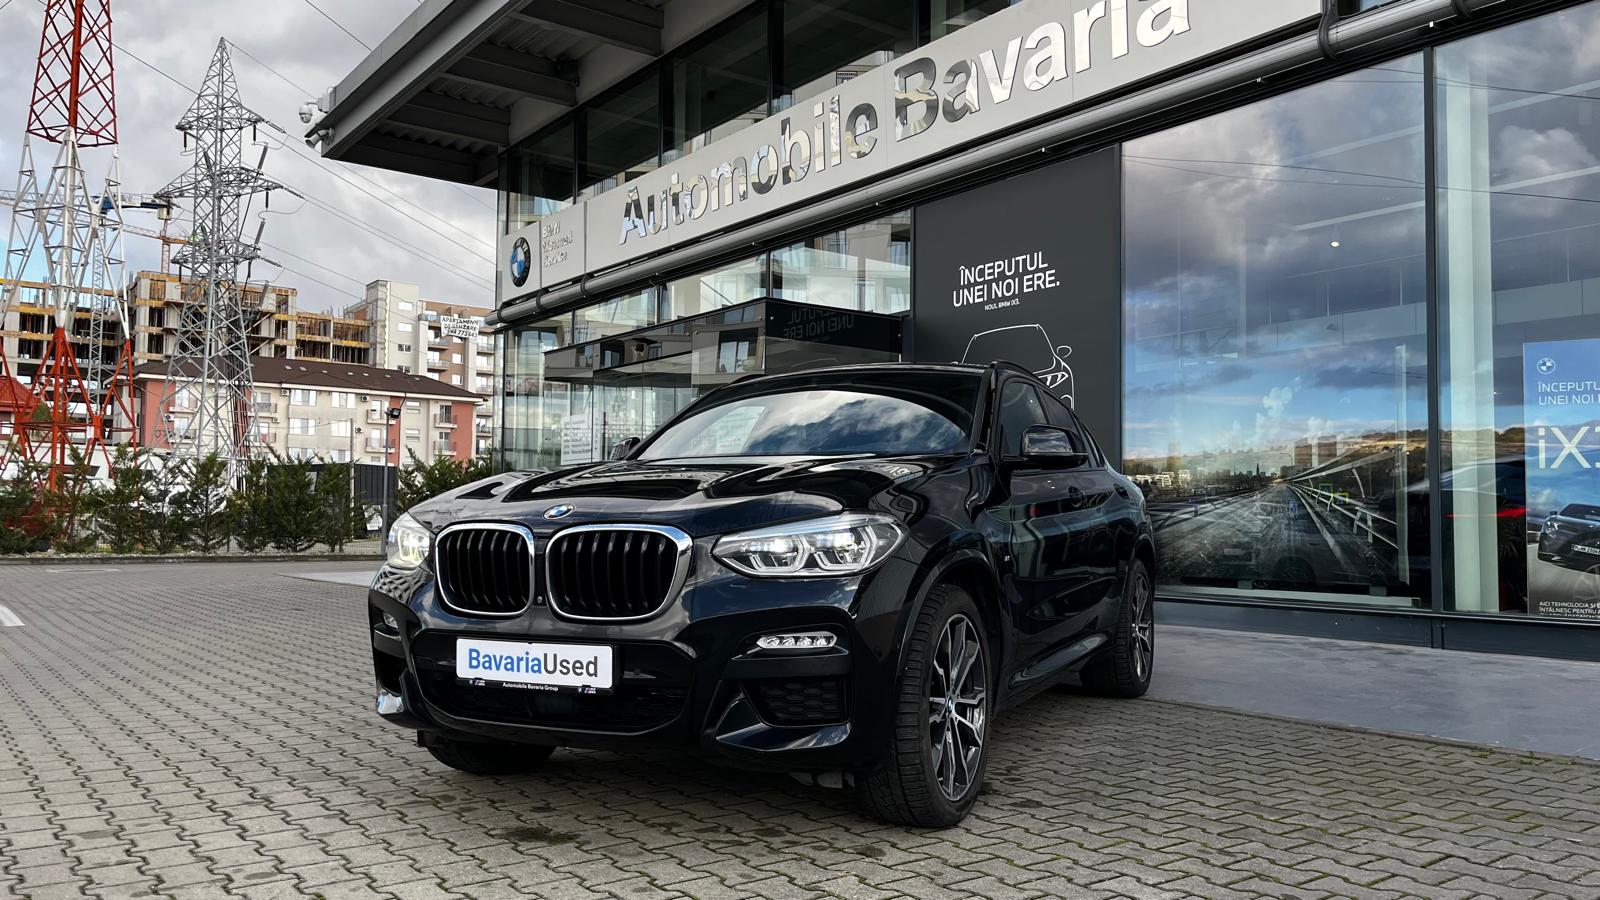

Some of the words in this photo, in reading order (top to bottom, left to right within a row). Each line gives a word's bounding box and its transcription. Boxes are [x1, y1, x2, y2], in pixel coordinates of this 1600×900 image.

[619, 94, 878, 244] Automobile
[894, 0, 1191, 142] Bavaria
[959, 251, 1048, 286] ÎNCEPUTUL
[953, 284, 987, 307] UNEI
[992, 277, 1018, 299] NOI
[1023, 269, 1060, 292] ERE.
[984, 303, 998, 311] NOUL
[1539, 395, 1568, 406] UNEI
[1572, 394, 1594, 404] NOI
[468, 648, 598, 678] BavariaUsed
